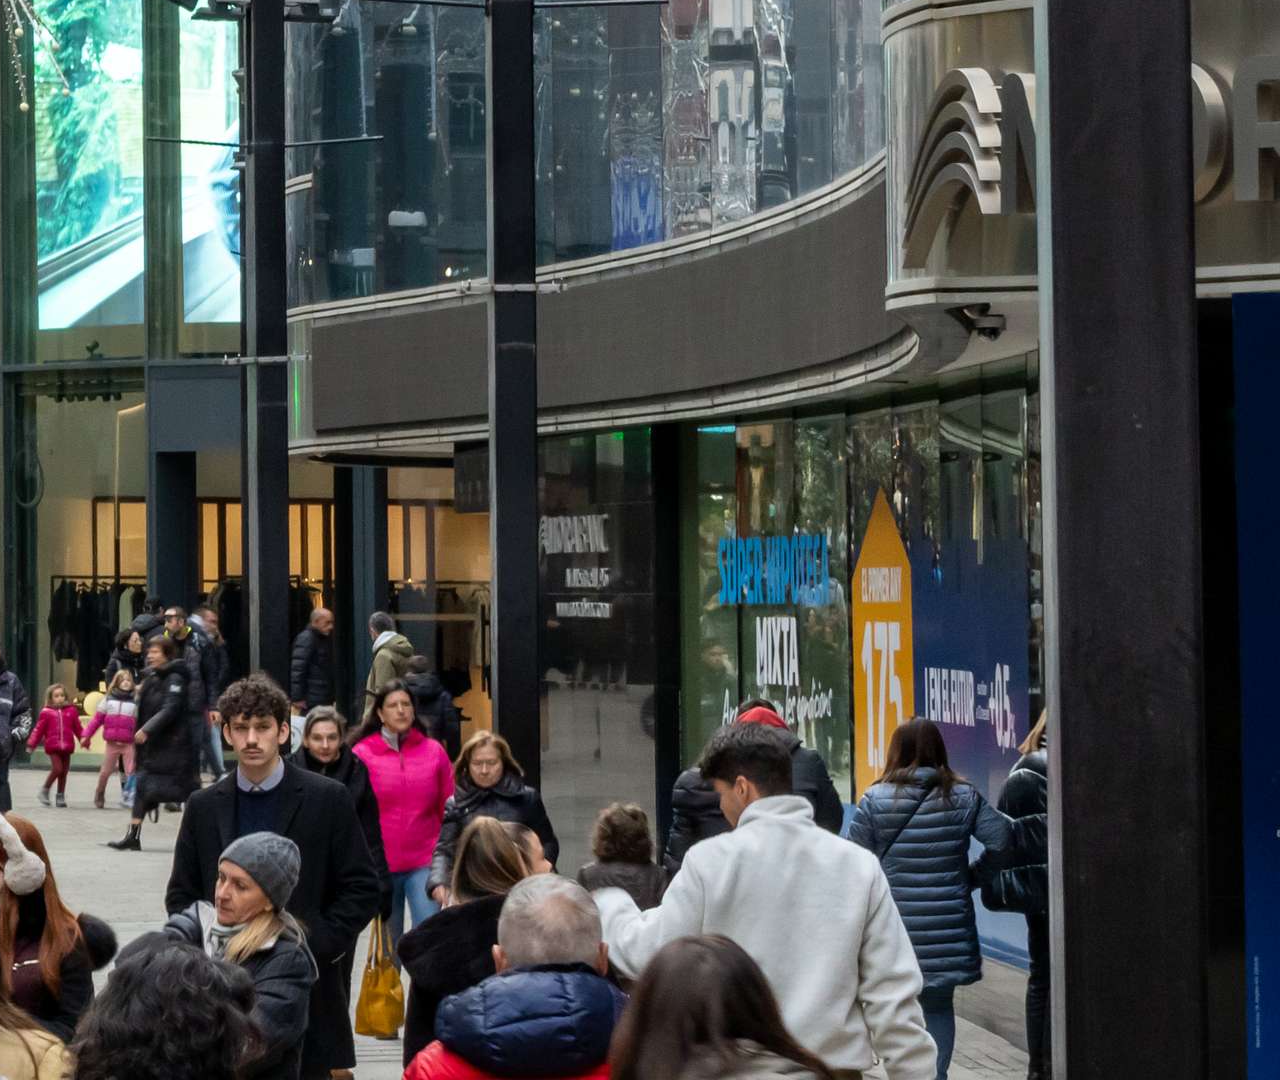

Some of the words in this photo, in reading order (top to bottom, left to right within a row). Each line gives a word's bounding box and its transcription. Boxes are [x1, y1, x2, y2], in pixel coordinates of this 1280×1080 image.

[717, 536, 764, 606] SUPER
[766, 533, 831, 608] HIPOTECA
[755, 615, 800, 687] MIXTA
[951, 669, 976, 728] FUTUR
